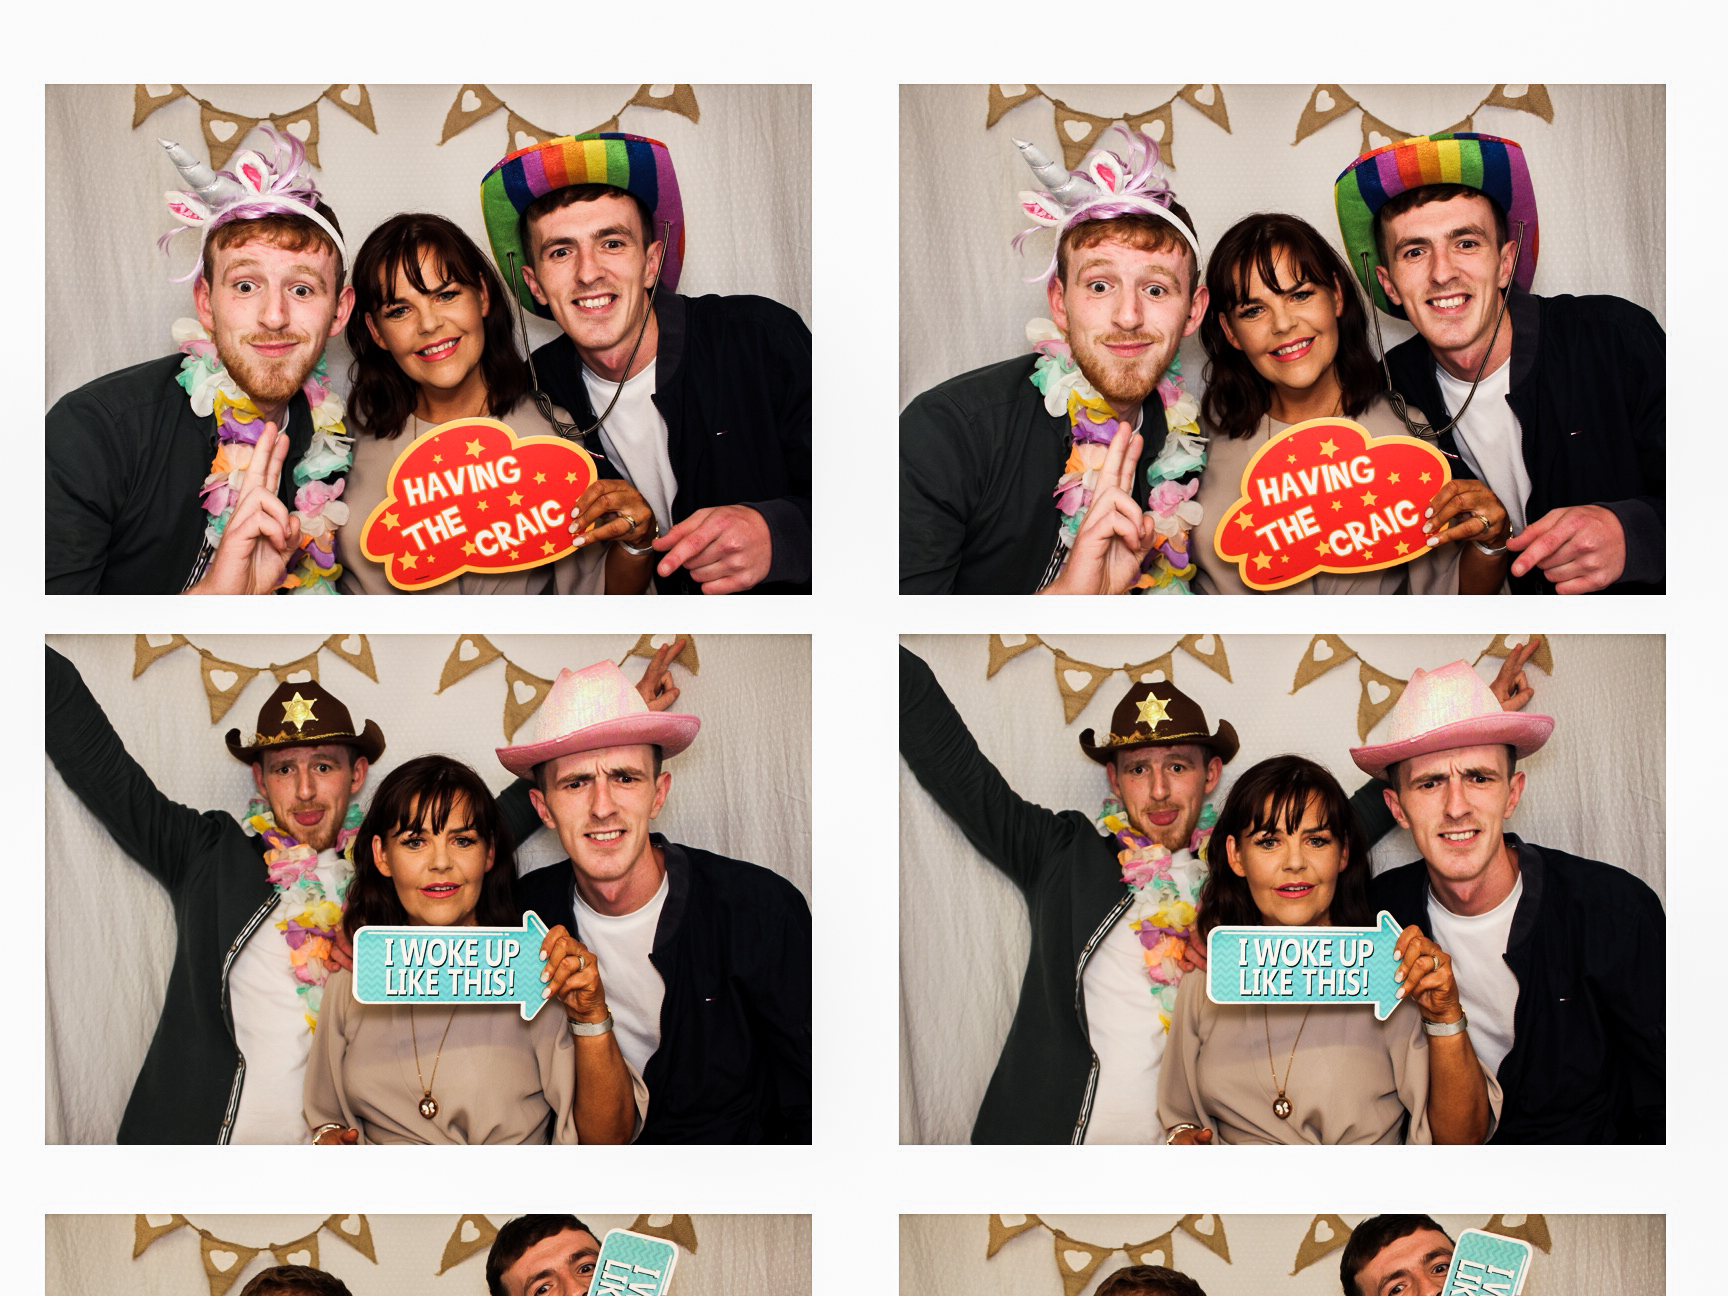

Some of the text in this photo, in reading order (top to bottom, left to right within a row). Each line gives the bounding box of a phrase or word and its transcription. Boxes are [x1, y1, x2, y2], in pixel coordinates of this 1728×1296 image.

[402, 455, 522, 507] HAVING
[1256, 455, 1376, 507] HAVING
[401, 499, 567, 557] THE CRAIC
[1255, 499, 1421, 557] THE CRAIC
[384, 938, 521, 968] I WOKE UP
[1238, 938, 1375, 968] I WOKE UP
[385, 968, 516, 996] LIKE THIS!
[1239, 968, 1370, 996] LIKE THIS!
